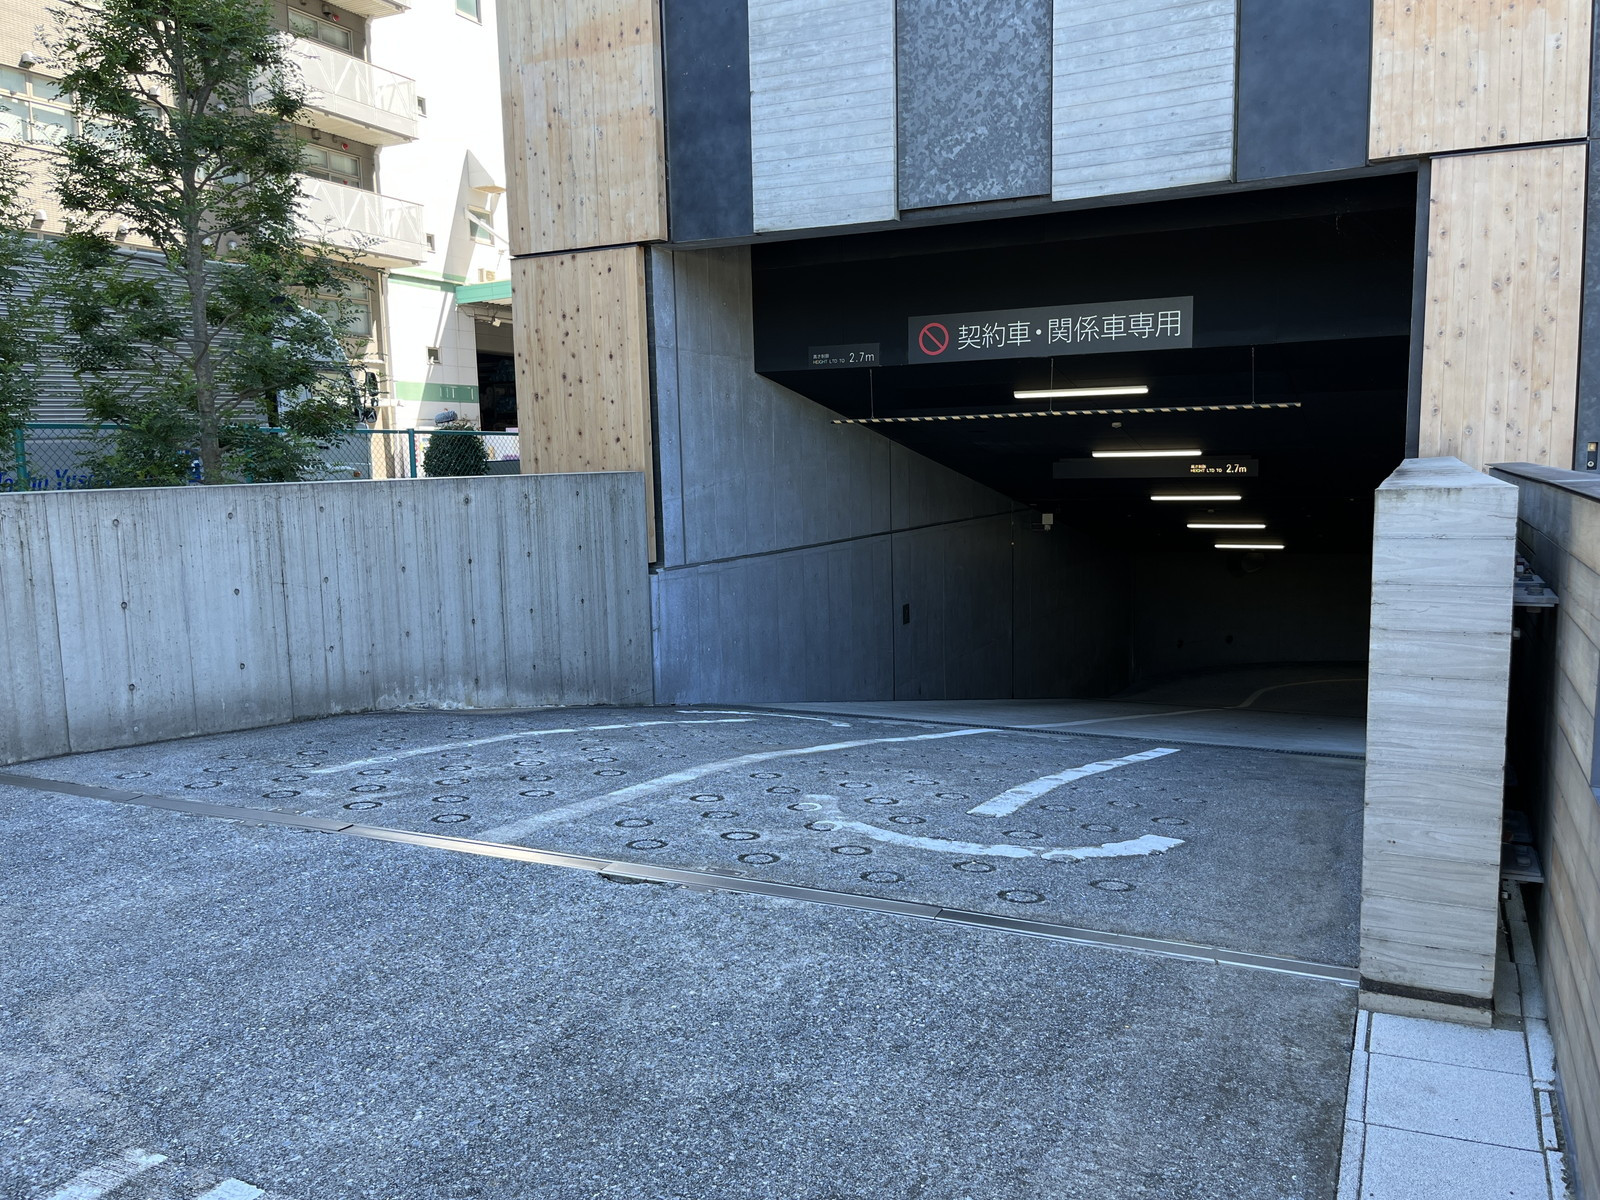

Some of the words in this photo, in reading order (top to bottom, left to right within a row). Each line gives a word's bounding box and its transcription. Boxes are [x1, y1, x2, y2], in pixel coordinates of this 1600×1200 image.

[957, 310, 1181, 350] 契約車・関係車専用
[849, 351, 875, 363] 2.7m
[1226, 463, 1247, 473] 2.7m
